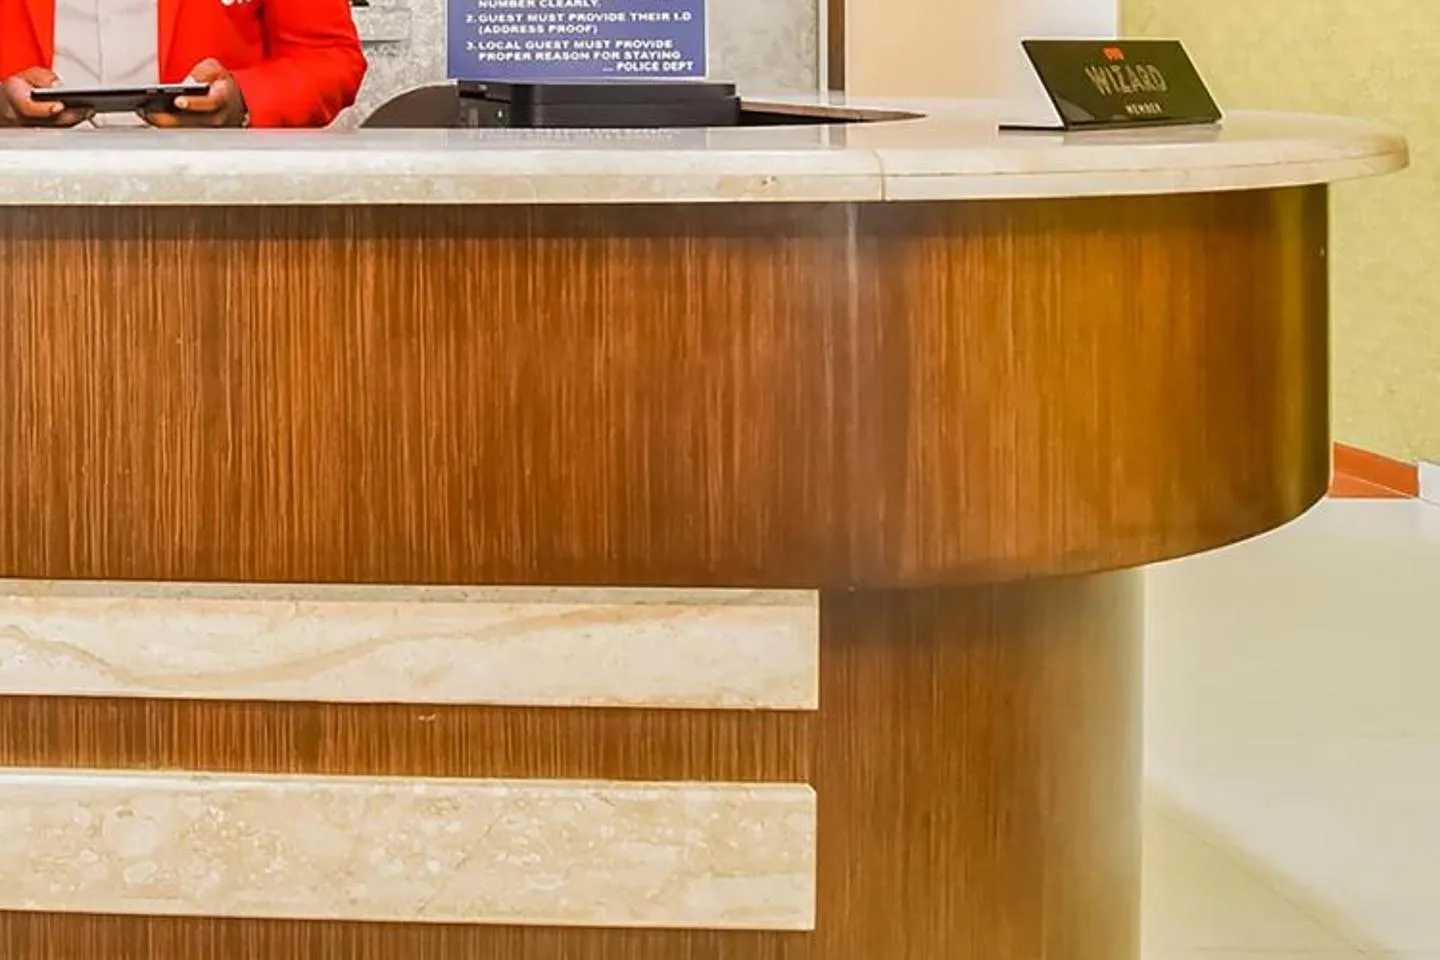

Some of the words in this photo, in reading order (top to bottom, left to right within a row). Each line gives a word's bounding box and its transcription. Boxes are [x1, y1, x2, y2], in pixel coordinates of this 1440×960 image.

[478, 0, 536, 9] NUMBER
[478, 13, 523, 23] GUEST
[527, 13, 565, 22] MUST
[568, 12, 626, 22] PROVIDE
[630, 12, 671, 21] THEIR
[478, 24, 545, 35] (ADDRESS
[548, 24, 598, 35] PROOF)
[478, 41, 520, 50] LOCAL
[525, 40, 569, 50] GUEST
[573, 40, 611, 49] MUST
[615, 40, 673, 49] PROVIDE
[479, 52, 532, 61] PROPER
[535, 52, 590, 61] REASON
[593, 52, 620, 61] FOR
[623, 51, 681, 60] STAYING
[616, 61, 660, 72] POLICE
[662, 61, 694, 71] DEPT
[1084, 64, 1168, 96] WIZARD
[1125, 102, 1163, 116] MEMBER
